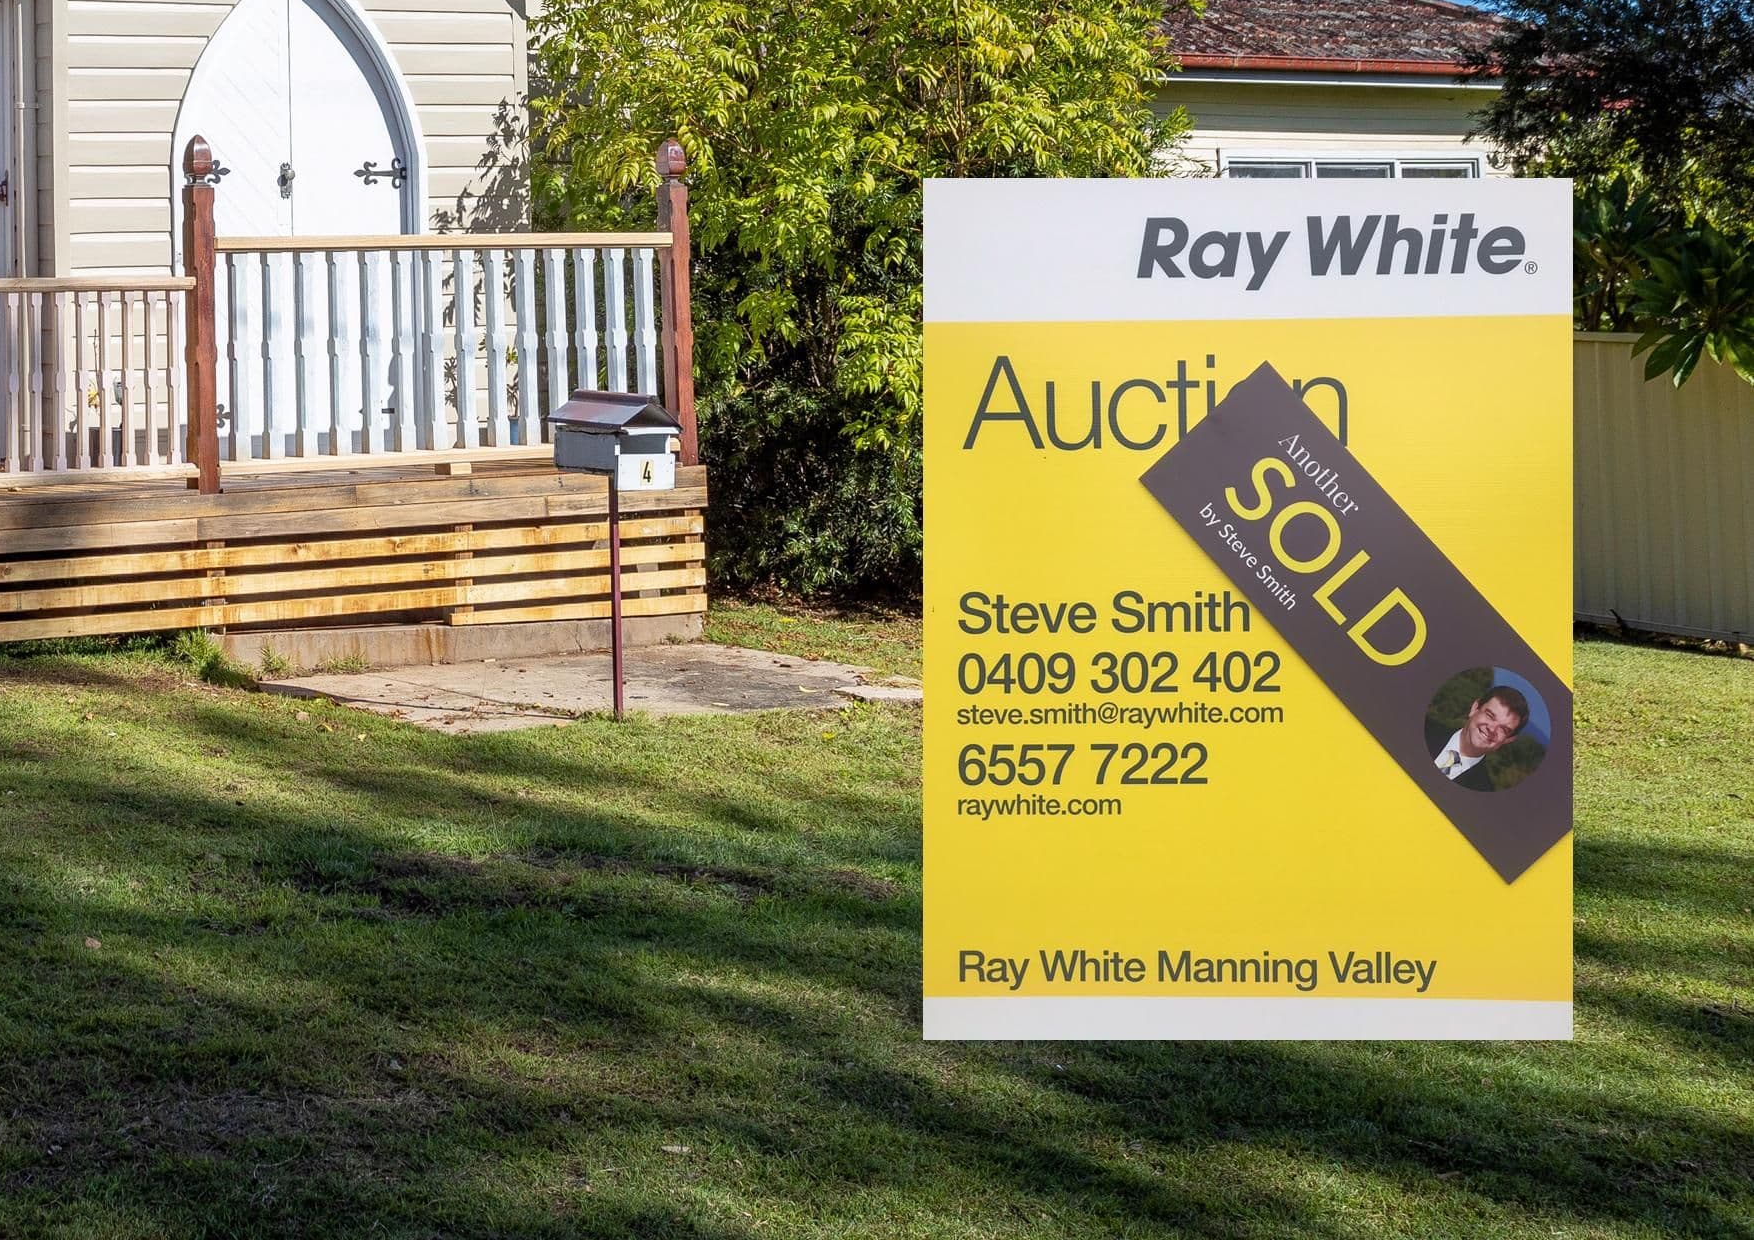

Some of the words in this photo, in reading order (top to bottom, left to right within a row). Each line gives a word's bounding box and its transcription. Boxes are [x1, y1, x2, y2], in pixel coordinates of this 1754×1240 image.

[1137, 217, 1291, 291] Ray
[962, 354, 1348, 451] Auctin
[642, 461, 652, 483] 4
[1278, 434, 1359, 516] Another
[1199, 502, 1221, 527] by
[1218, 524, 1258, 568] Steve
[1256, 565, 1297, 611] Smith
[1225, 457, 1428, 666] SOLD
[958, 591, 1097, 634] Steve
[1111, 590, 1250, 633] Smith
[958, 652, 1077, 694] 0409
[1090, 651, 1179, 693] 302
[1192, 651, 1281, 693] 402
[957, 701, 1283, 729] steve.smith@raywhite.com
[958, 743, 1075, 786] 6557
[1090, 742, 1208, 785] 7222
[957, 794, 1122, 820] raywhite.com
[958, 950, 1030, 991] Ray
[1039, 950, 1146, 982] White
[1157, 951, 1318, 991] Manning
[1329, 951, 1437, 992] Valley
